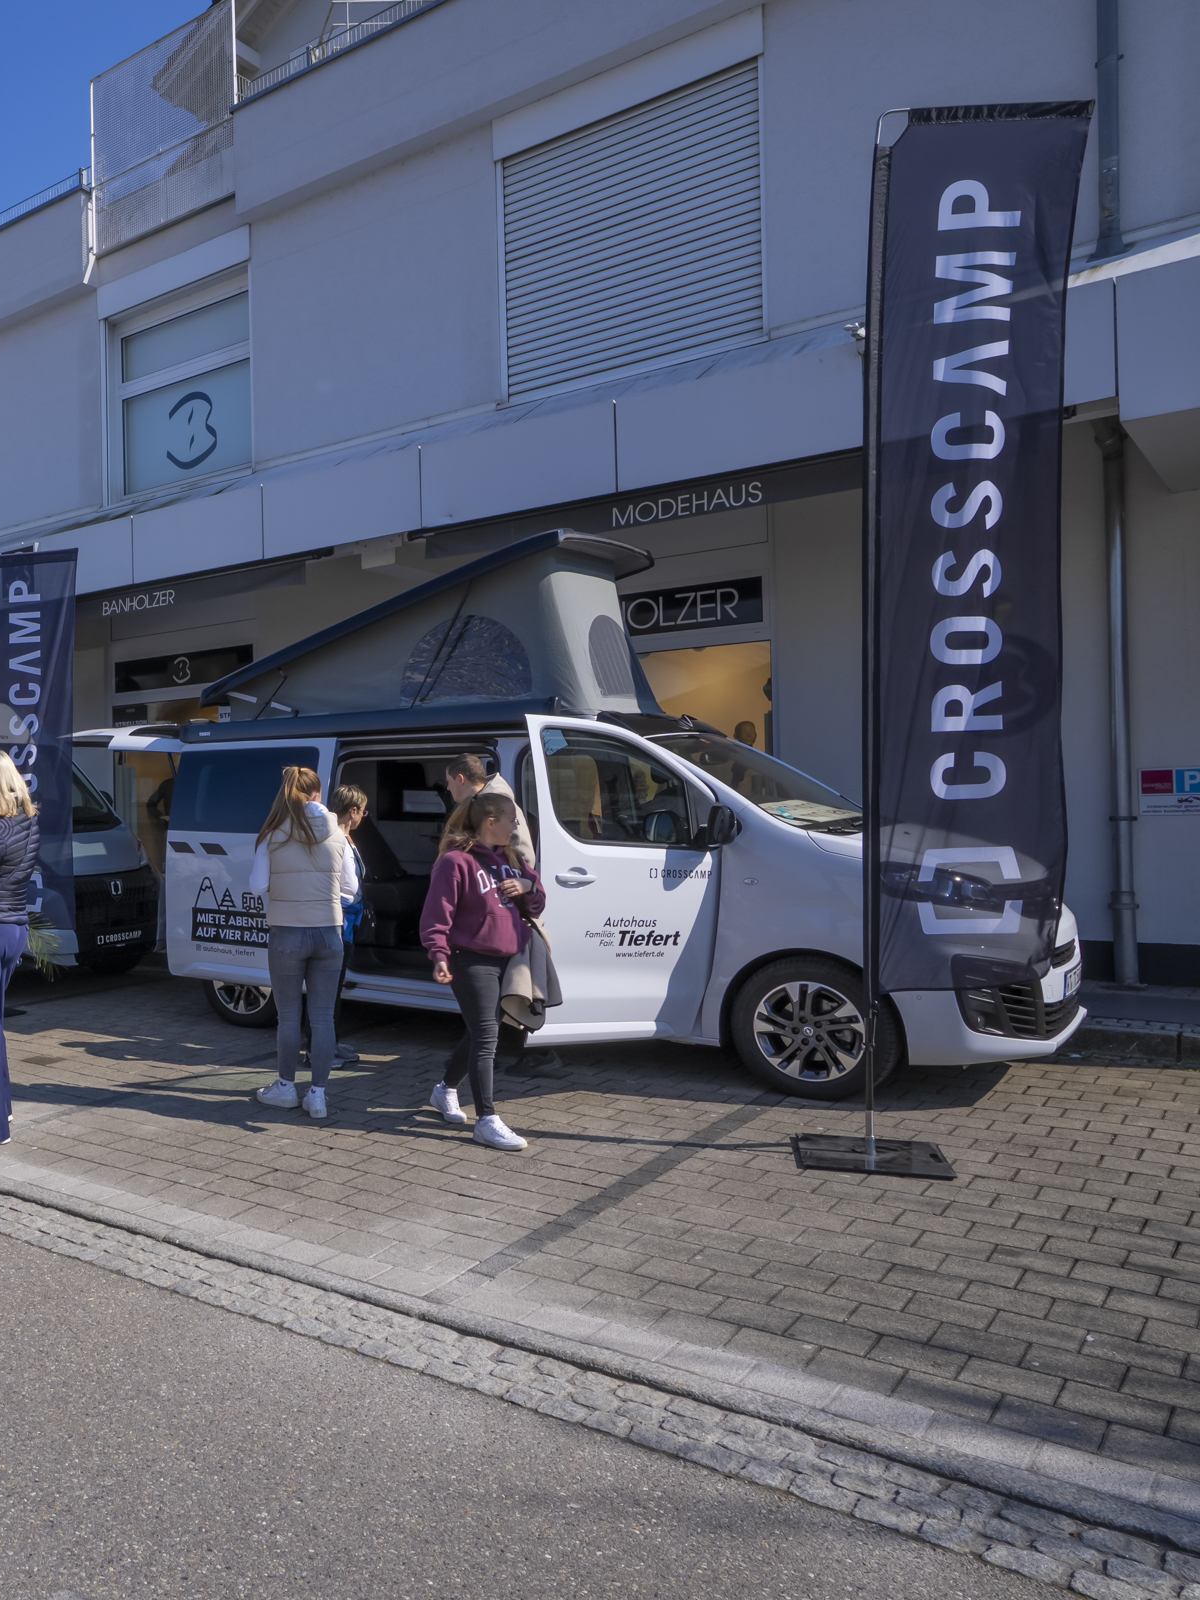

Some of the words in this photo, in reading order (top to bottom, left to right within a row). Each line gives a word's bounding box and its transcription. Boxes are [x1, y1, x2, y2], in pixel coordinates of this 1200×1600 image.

[930, 179, 1022, 800] CROSSCAMP
[612, 482, 763, 527] MODEHAUS
[102, 589, 175, 616] BANHOLZER
[1183, 770, 1200, 791] P
[660, 869, 713, 879] CROSSCAMP
[196, 912, 226, 925] MIETE
[228, 915, 269, 929] ABENTE
[603, 916, 657, 928] Autohaus
[105, 930, 142, 943] CROSSCAMP
[195, 926, 217, 938] AUF
[219, 928, 242, 941] VIER
[584, 930, 616, 938] Familiär.
[618, 930, 681, 947] Tiefert
[599, 939, 615, 947] Fair.
[202, 945, 256, 957] autohaus_tiefert
[615, 950, 665, 958] www.tiefert.de
